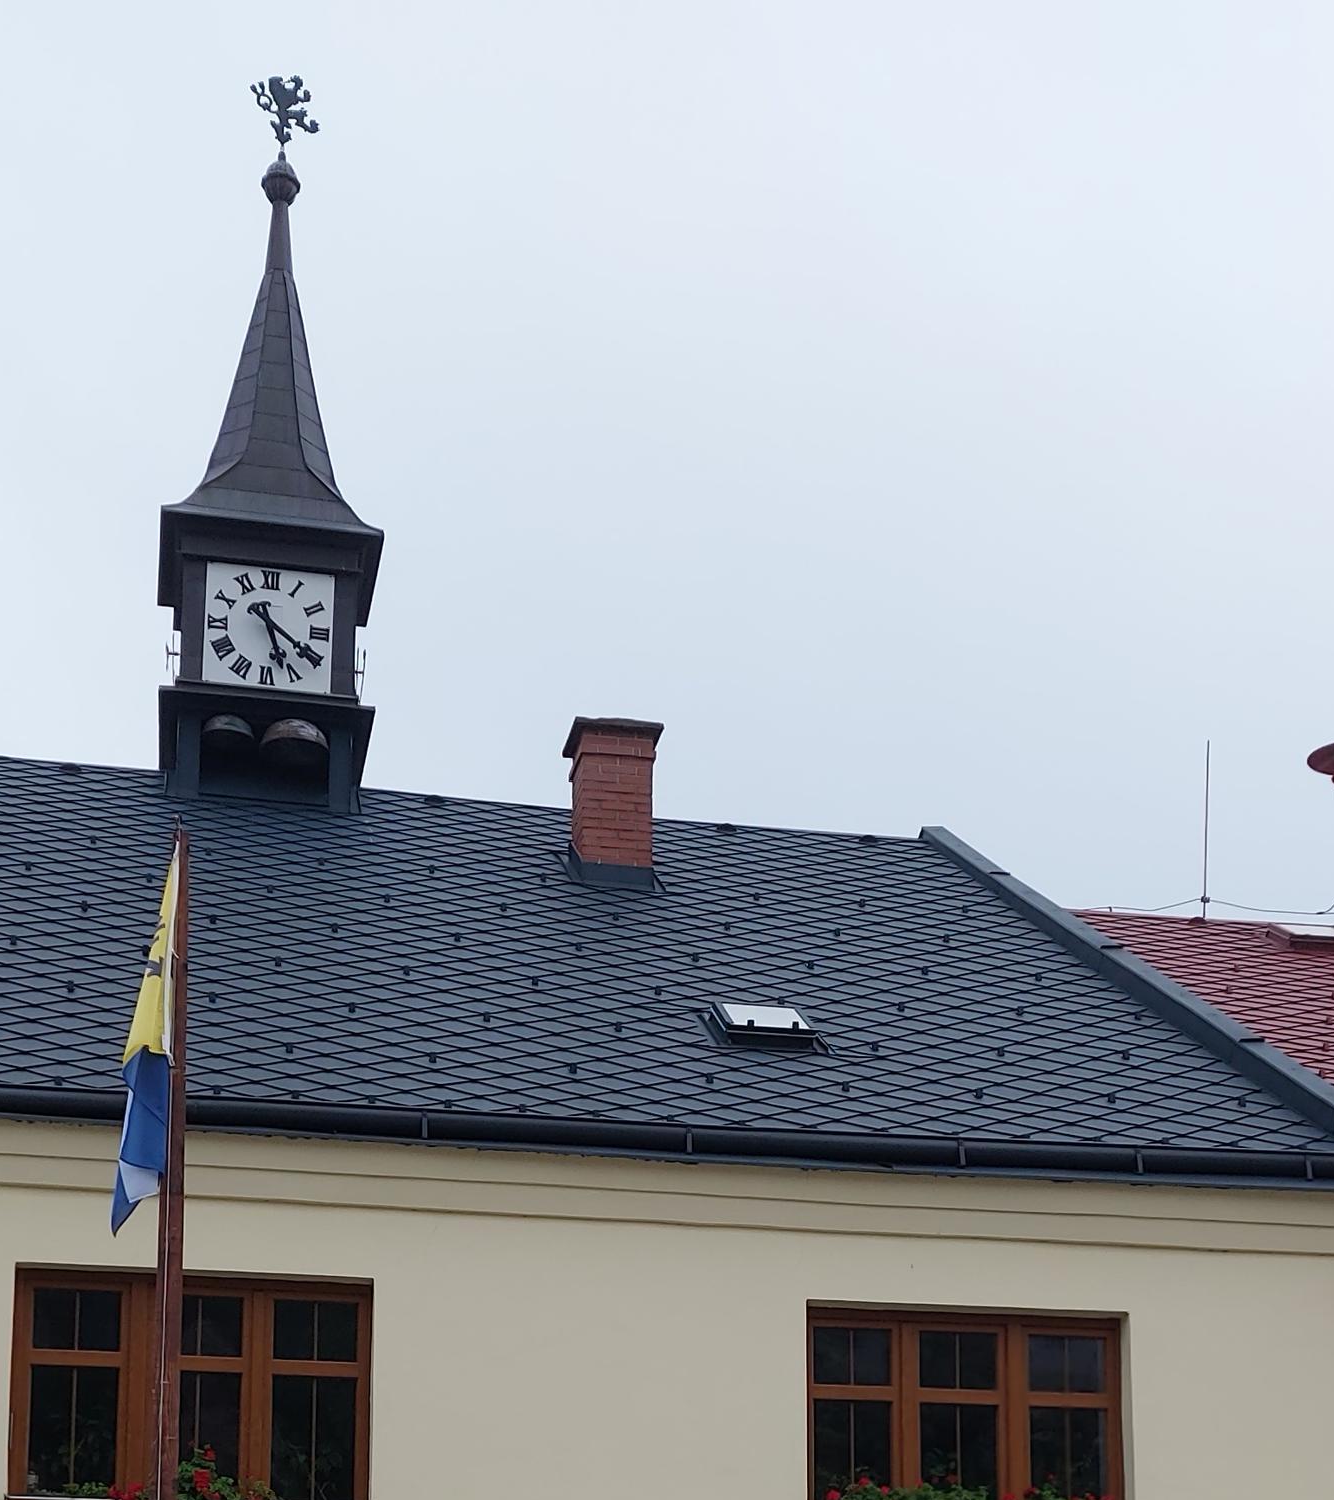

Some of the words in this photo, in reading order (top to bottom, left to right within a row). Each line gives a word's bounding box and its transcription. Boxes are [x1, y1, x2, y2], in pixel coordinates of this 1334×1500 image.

[233, 572, 256, 595] XI
[260, 570, 281, 590] XII
[288, 580, 304, 597] I
[214, 589, 237, 609] X
[303, 601, 324, 617] II
[208, 613, 228, 631] IX
[309, 625, 330, 642] III
[258, 665, 275, 686] VI
[286, 663, 303, 682] V
